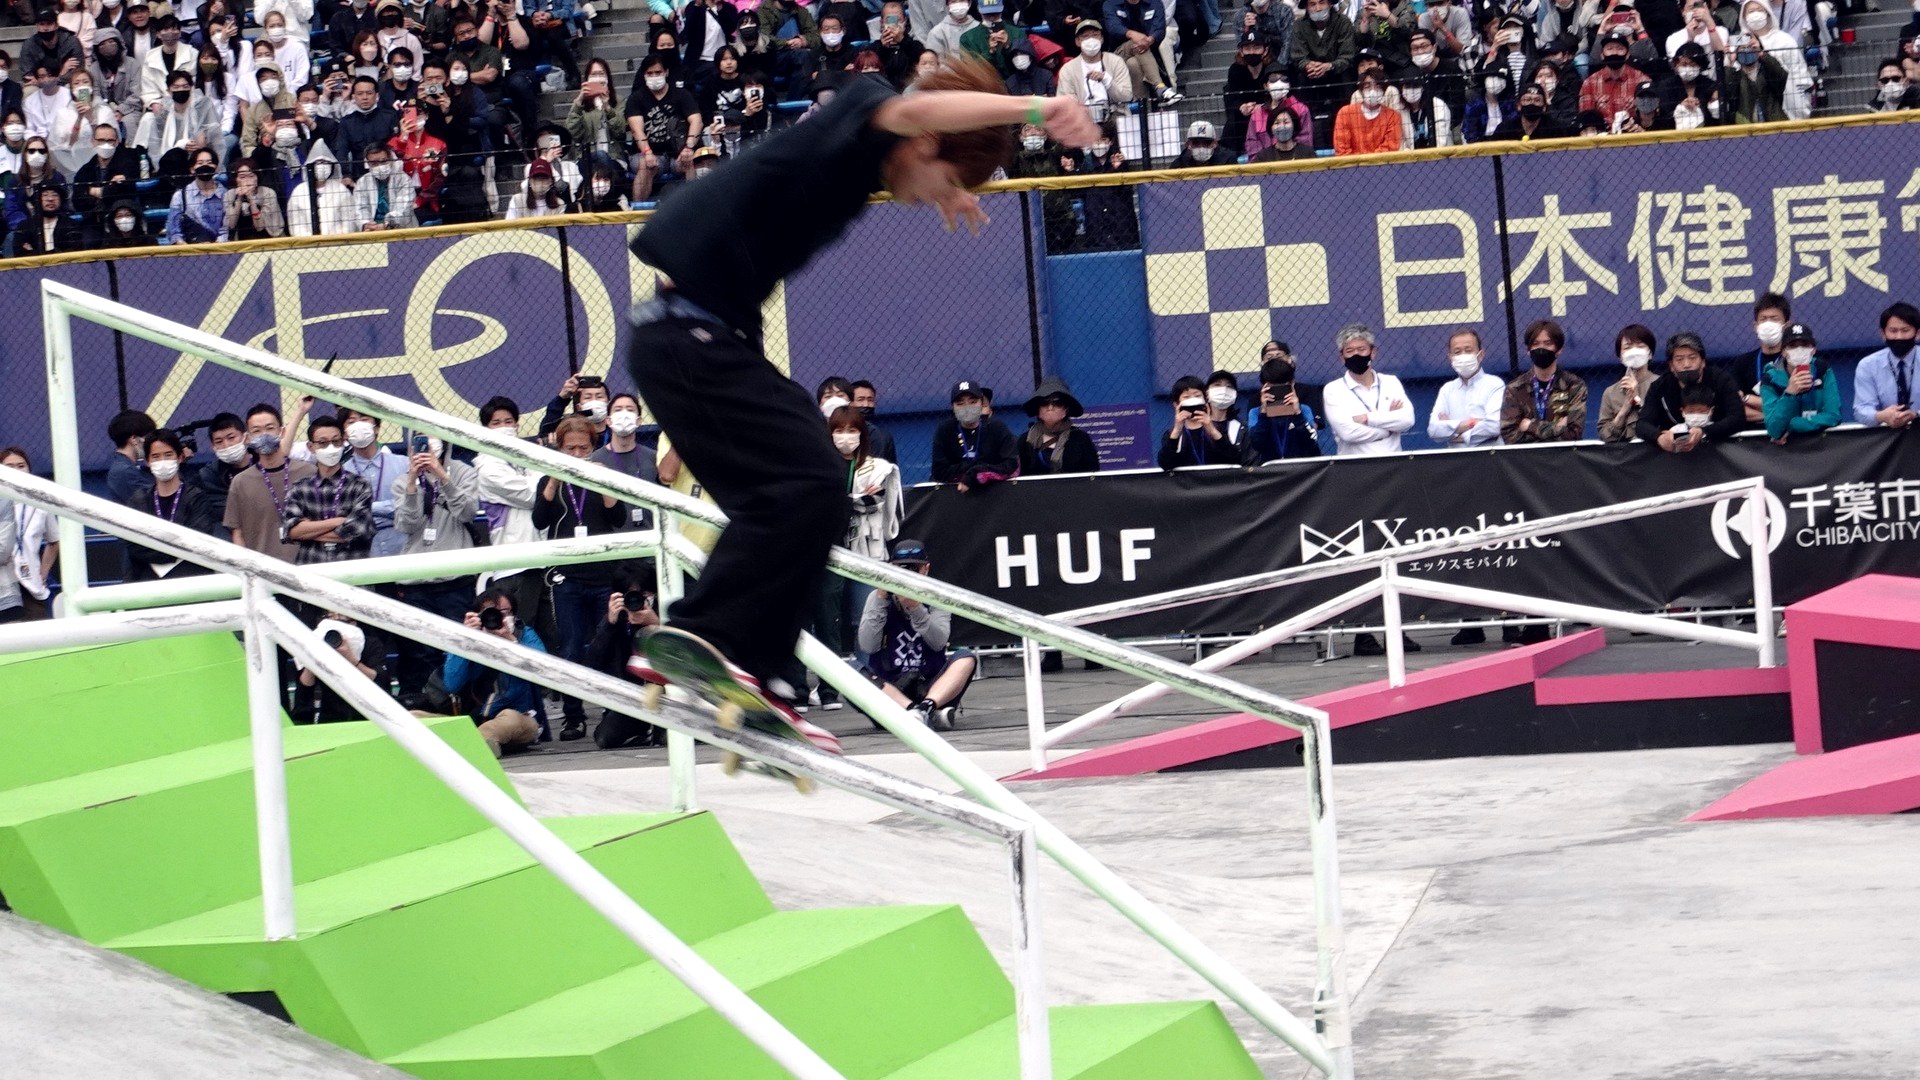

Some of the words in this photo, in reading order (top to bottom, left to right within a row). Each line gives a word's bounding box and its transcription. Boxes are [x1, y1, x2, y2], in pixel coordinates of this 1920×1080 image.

[1790, 478, 1920, 527] 千葉市
[995, 528, 1155, 588] HUF
[1408, 555, 1518, 572] エックスモバイル
